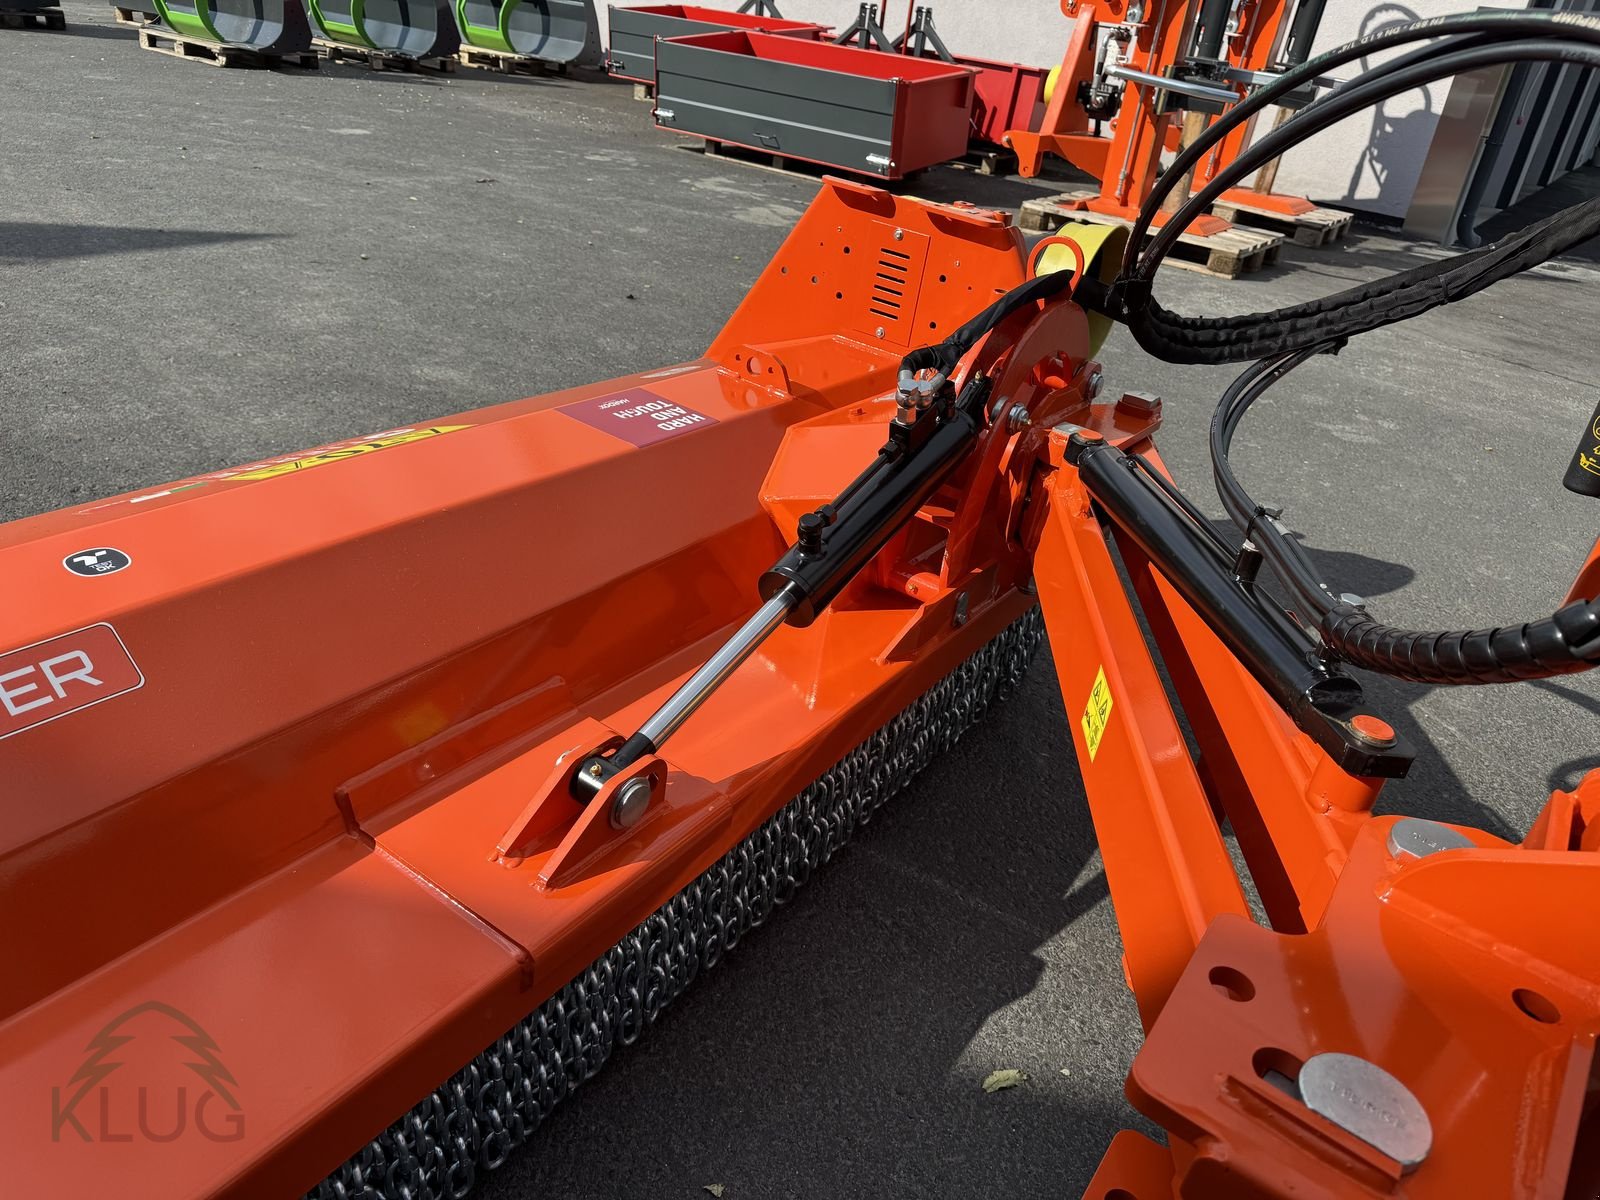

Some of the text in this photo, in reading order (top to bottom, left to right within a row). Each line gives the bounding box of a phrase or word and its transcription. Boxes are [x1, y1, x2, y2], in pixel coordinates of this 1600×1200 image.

[1385, 25, 1401, 36] DN
[612, 400, 673, 419] TOUGH
[650, 406, 687, 421] AND
[657, 413, 705, 431] HARD
